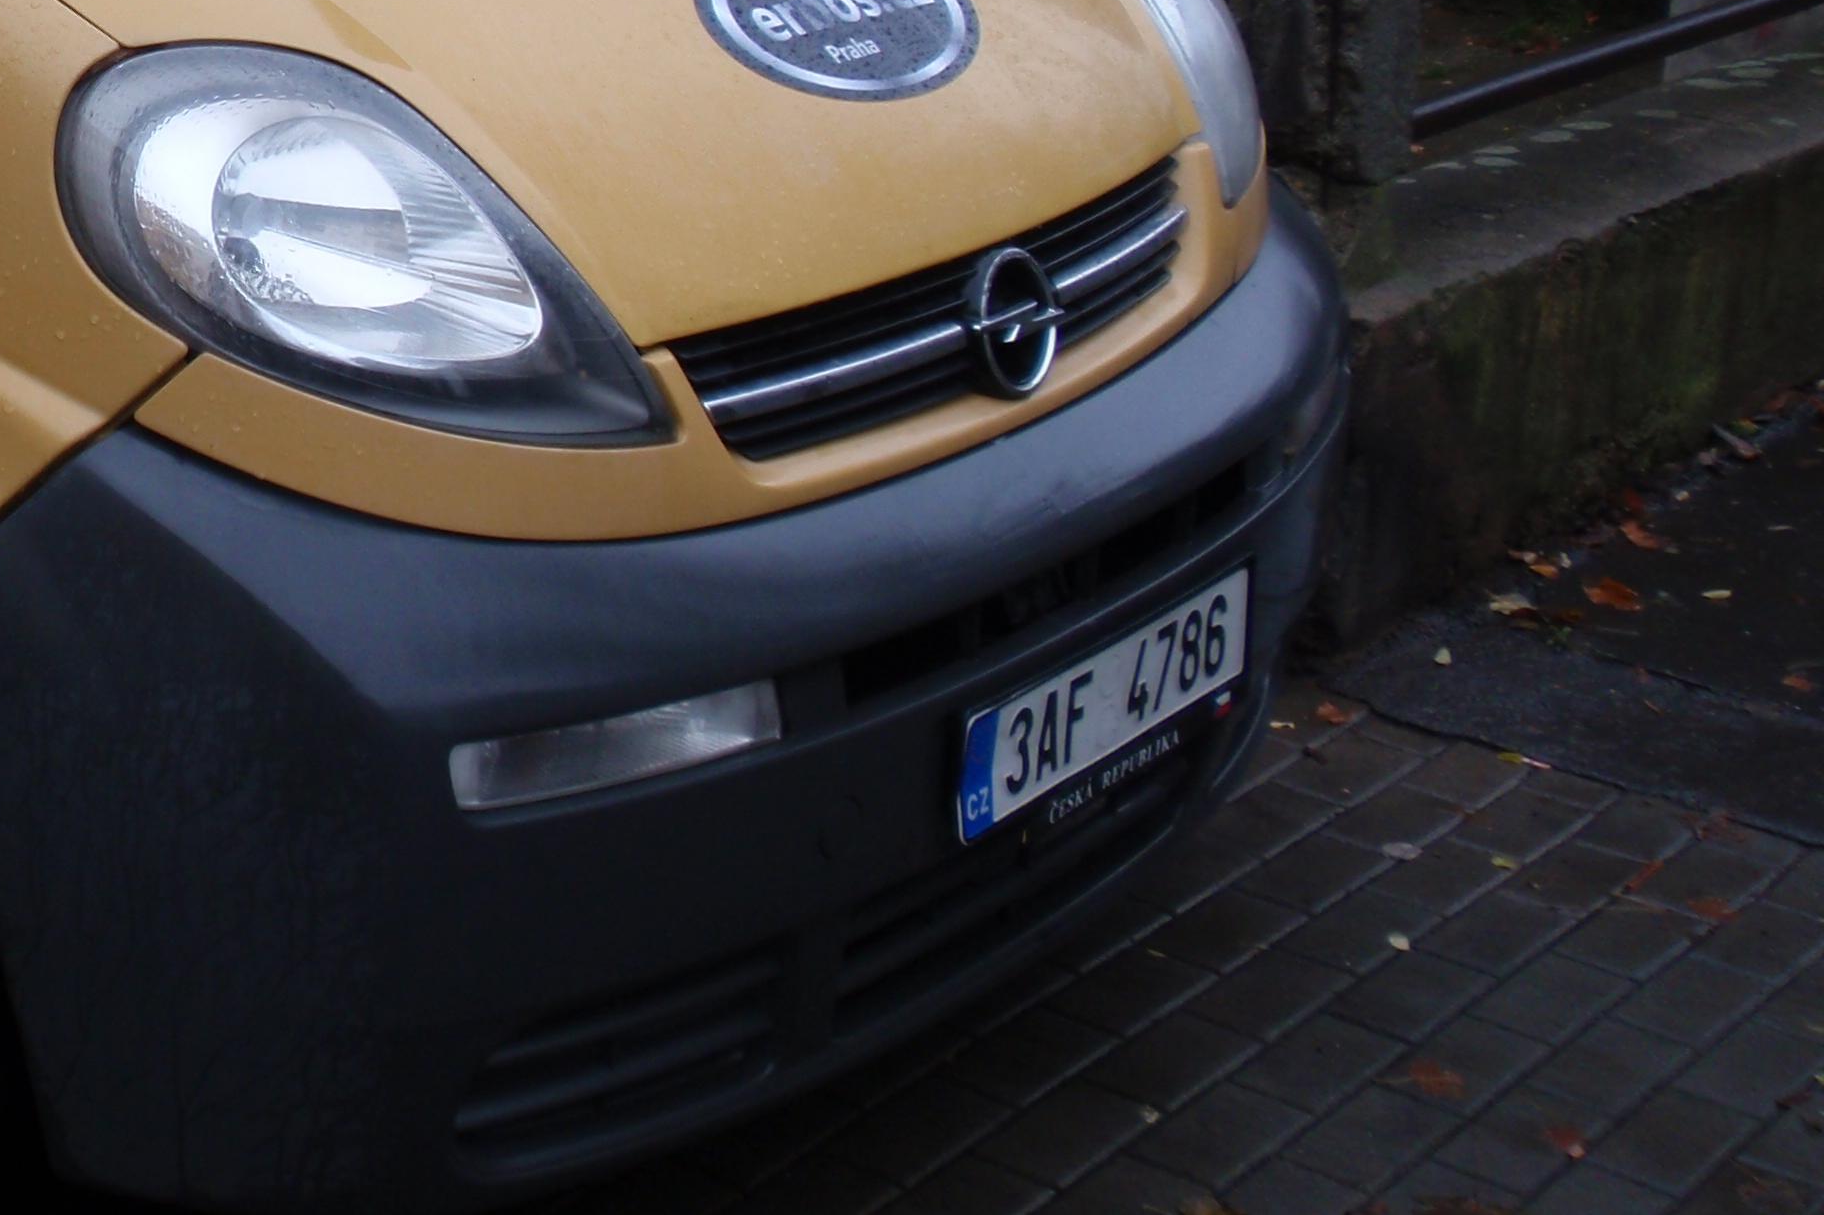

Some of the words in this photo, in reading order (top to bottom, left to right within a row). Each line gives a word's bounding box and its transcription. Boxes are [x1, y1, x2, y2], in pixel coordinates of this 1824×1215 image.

[825, 38, 880, 64] Praha
[1006, 670, 1094, 795] 3AF
[1128, 594, 1228, 721] 4786
[967, 787, 989, 821] CZ
